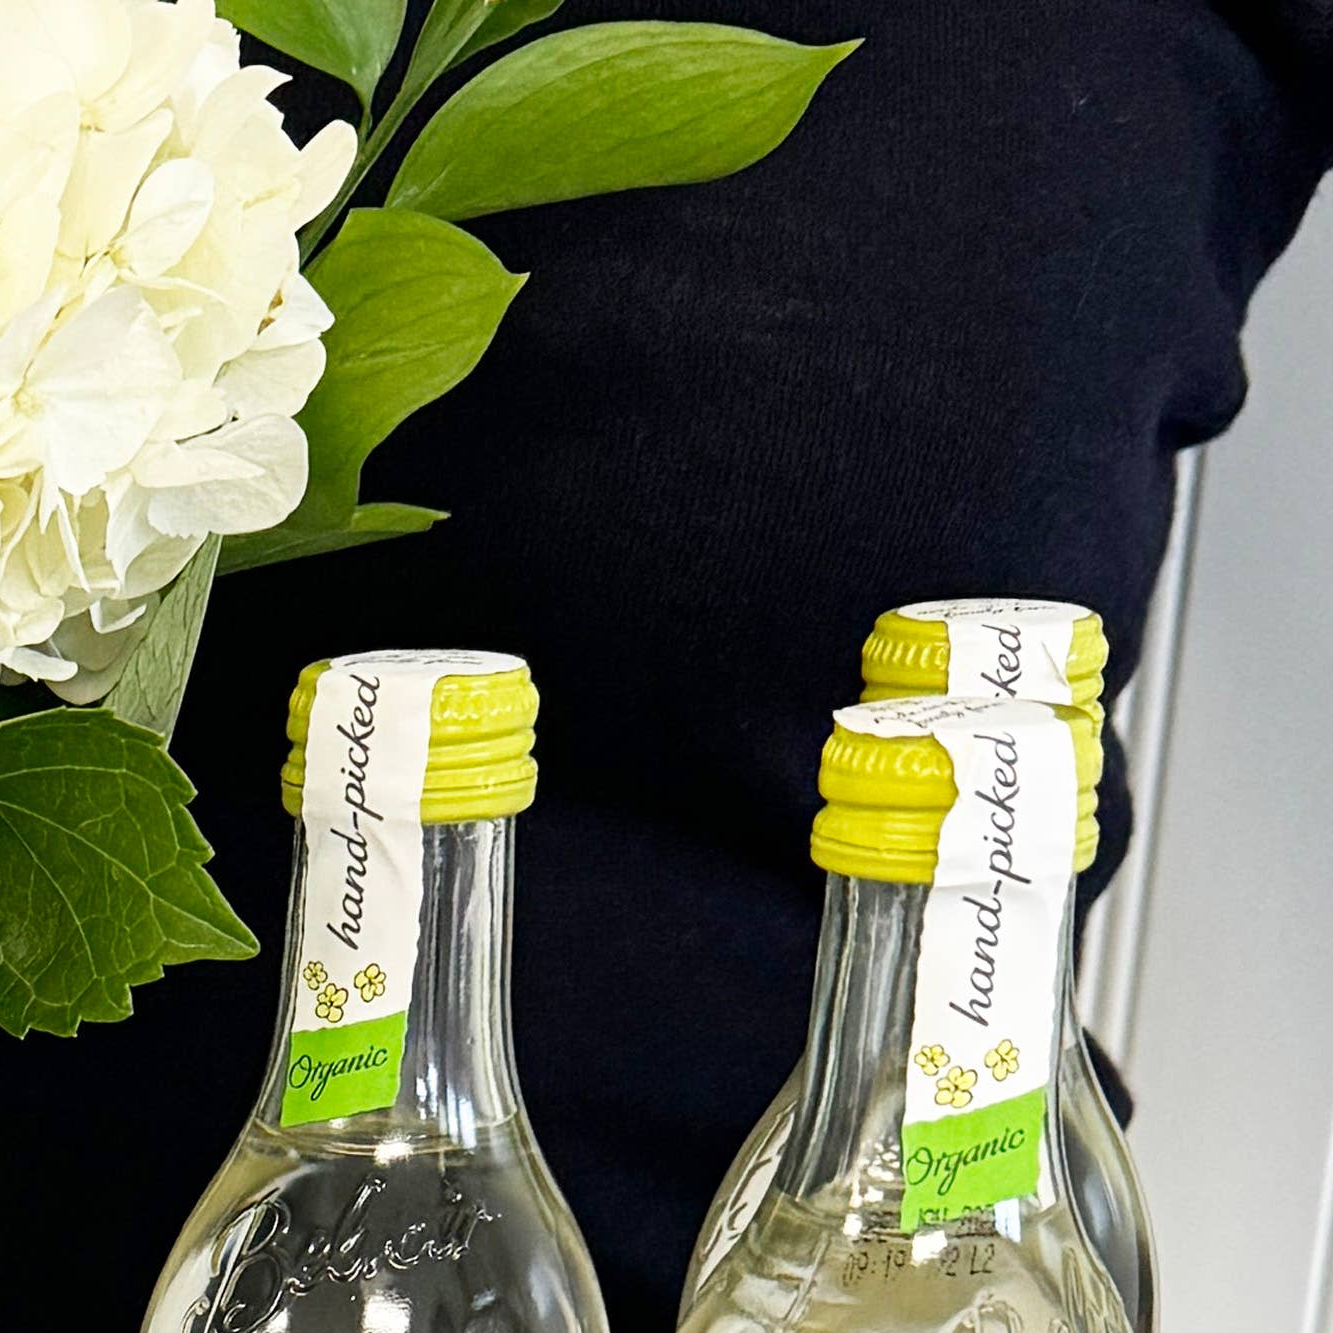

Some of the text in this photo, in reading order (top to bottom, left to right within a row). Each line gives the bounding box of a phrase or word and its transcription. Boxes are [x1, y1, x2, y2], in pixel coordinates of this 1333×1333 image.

[326, 673, 385, 951] hand-picked
[949, 731, 1032, 1027] hand-picked
[288, 1045, 388, 1102] Organic
[906, 1127, 1026, 1196] Organic
